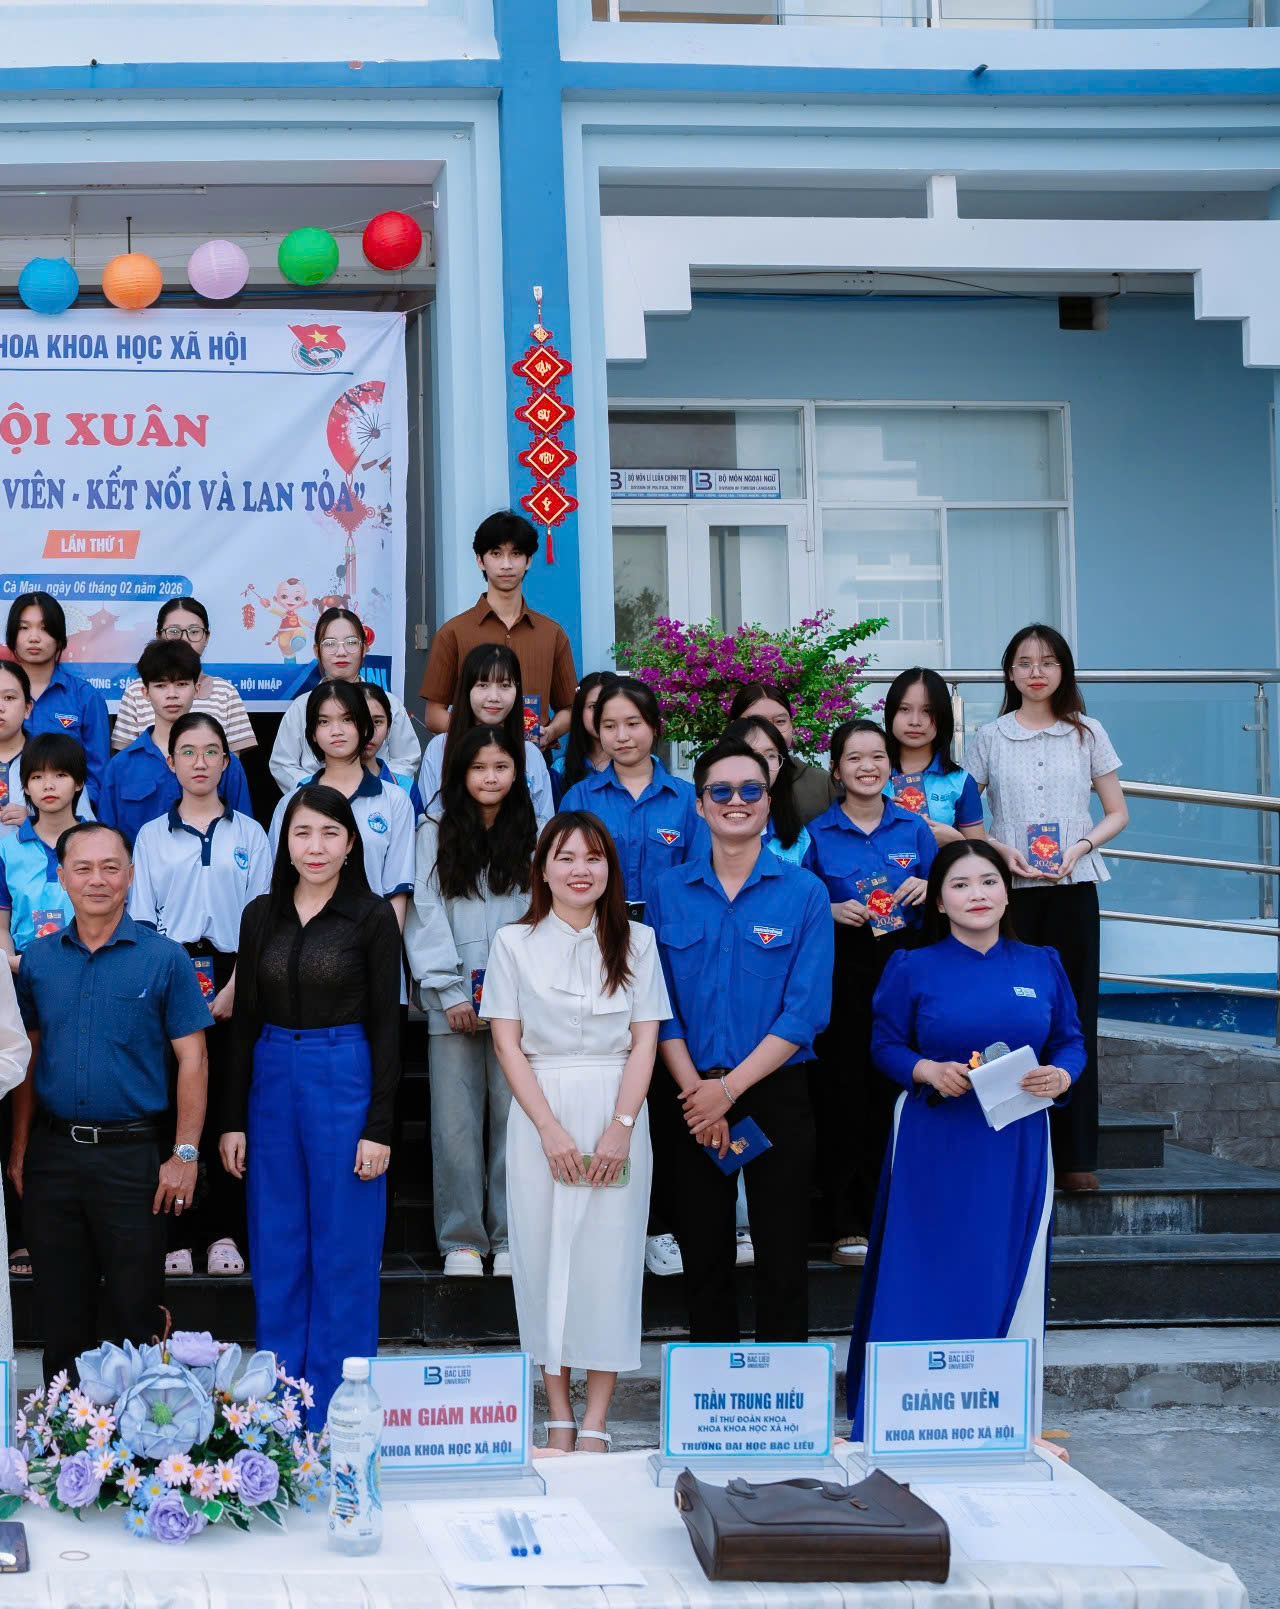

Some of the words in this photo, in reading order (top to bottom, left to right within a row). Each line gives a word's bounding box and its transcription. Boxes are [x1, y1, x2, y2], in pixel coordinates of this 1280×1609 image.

[47, 334, 108, 359] KHOA
[116, 335, 162, 364] HỌC
[170, 331, 201, 360] XÃ
[209, 331, 247, 365] HỘI
[65, 404, 209, 447] XUÂN
[2, 469, 65, 509] VIÊN
[72, 493, 79, 501] -
[86, 464, 138, 510] KẾT
[145, 465, 191, 510] NỐI
[198, 471, 235, 511] VÀ
[243, 481, 294, 512] LAN
[61, 533, 86, 552] LẦN
[90, 534, 115, 552] THỨ
[118, 538, 123, 552] 1
[3, 580, 16, 593] Cà
[46, 581, 71, 595] ngày
[73, 581, 86, 593] 06
[88, 580, 118, 596] tháng
[120, 581, 132, 593] 02
[134, 581, 156, 594] năm
[159, 581, 182, 594] 2026
[240, 678, 255, 691] HỘI
[257, 678, 282, 691] NHẬP
[876, 914, 896, 928] 2026
[444, 1370, 457, 1378] BAC
[458, 1369, 471, 1377] LIEU
[694, 1388, 726, 1410] TRẦN
[730, 1392, 771, 1410] TRUNG
[776, 1387, 804, 1410] HIẾU
[902, 1389, 955, 1411] GIẢNG
[960, 1388, 999, 1409] VIÊN
[418, 1405, 464, 1426] GIÁM
[470, 1400, 517, 1424] KHẢO
[710, 1414, 718, 1423] BÍ
[737, 1414, 760, 1422] ĐOÀN
[749, 1425, 768, 1434] HỌC
[770, 1424, 782, 1432] XÃ
[784, 1423, 798, 1434] HỘI
[885, 1430, 915, 1442] KHOA
[918, 1428, 948, 1440] KHOA
[952, 1428, 974, 1441] HỌC
[978, 1426, 992, 1439] XÃ
[996, 1425, 1014, 1440] HỘI
[380, 1445, 411, 1456] KHOA
[414, 1444, 445, 1456] KHOA
[448, 1442, 472, 1456] HỌC
[474, 1441, 488, 1454] XÃ
[492, 1440, 512, 1455] HỘI
[682, 1440, 722, 1450] TRƯỜNG
[725, 1442, 742, 1452] ĐẠI
[746, 1442, 766, 1452] HỌC
[770, 1442, 790, 1452] BẠC
[794, 1440, 814, 1450] LIÊU
